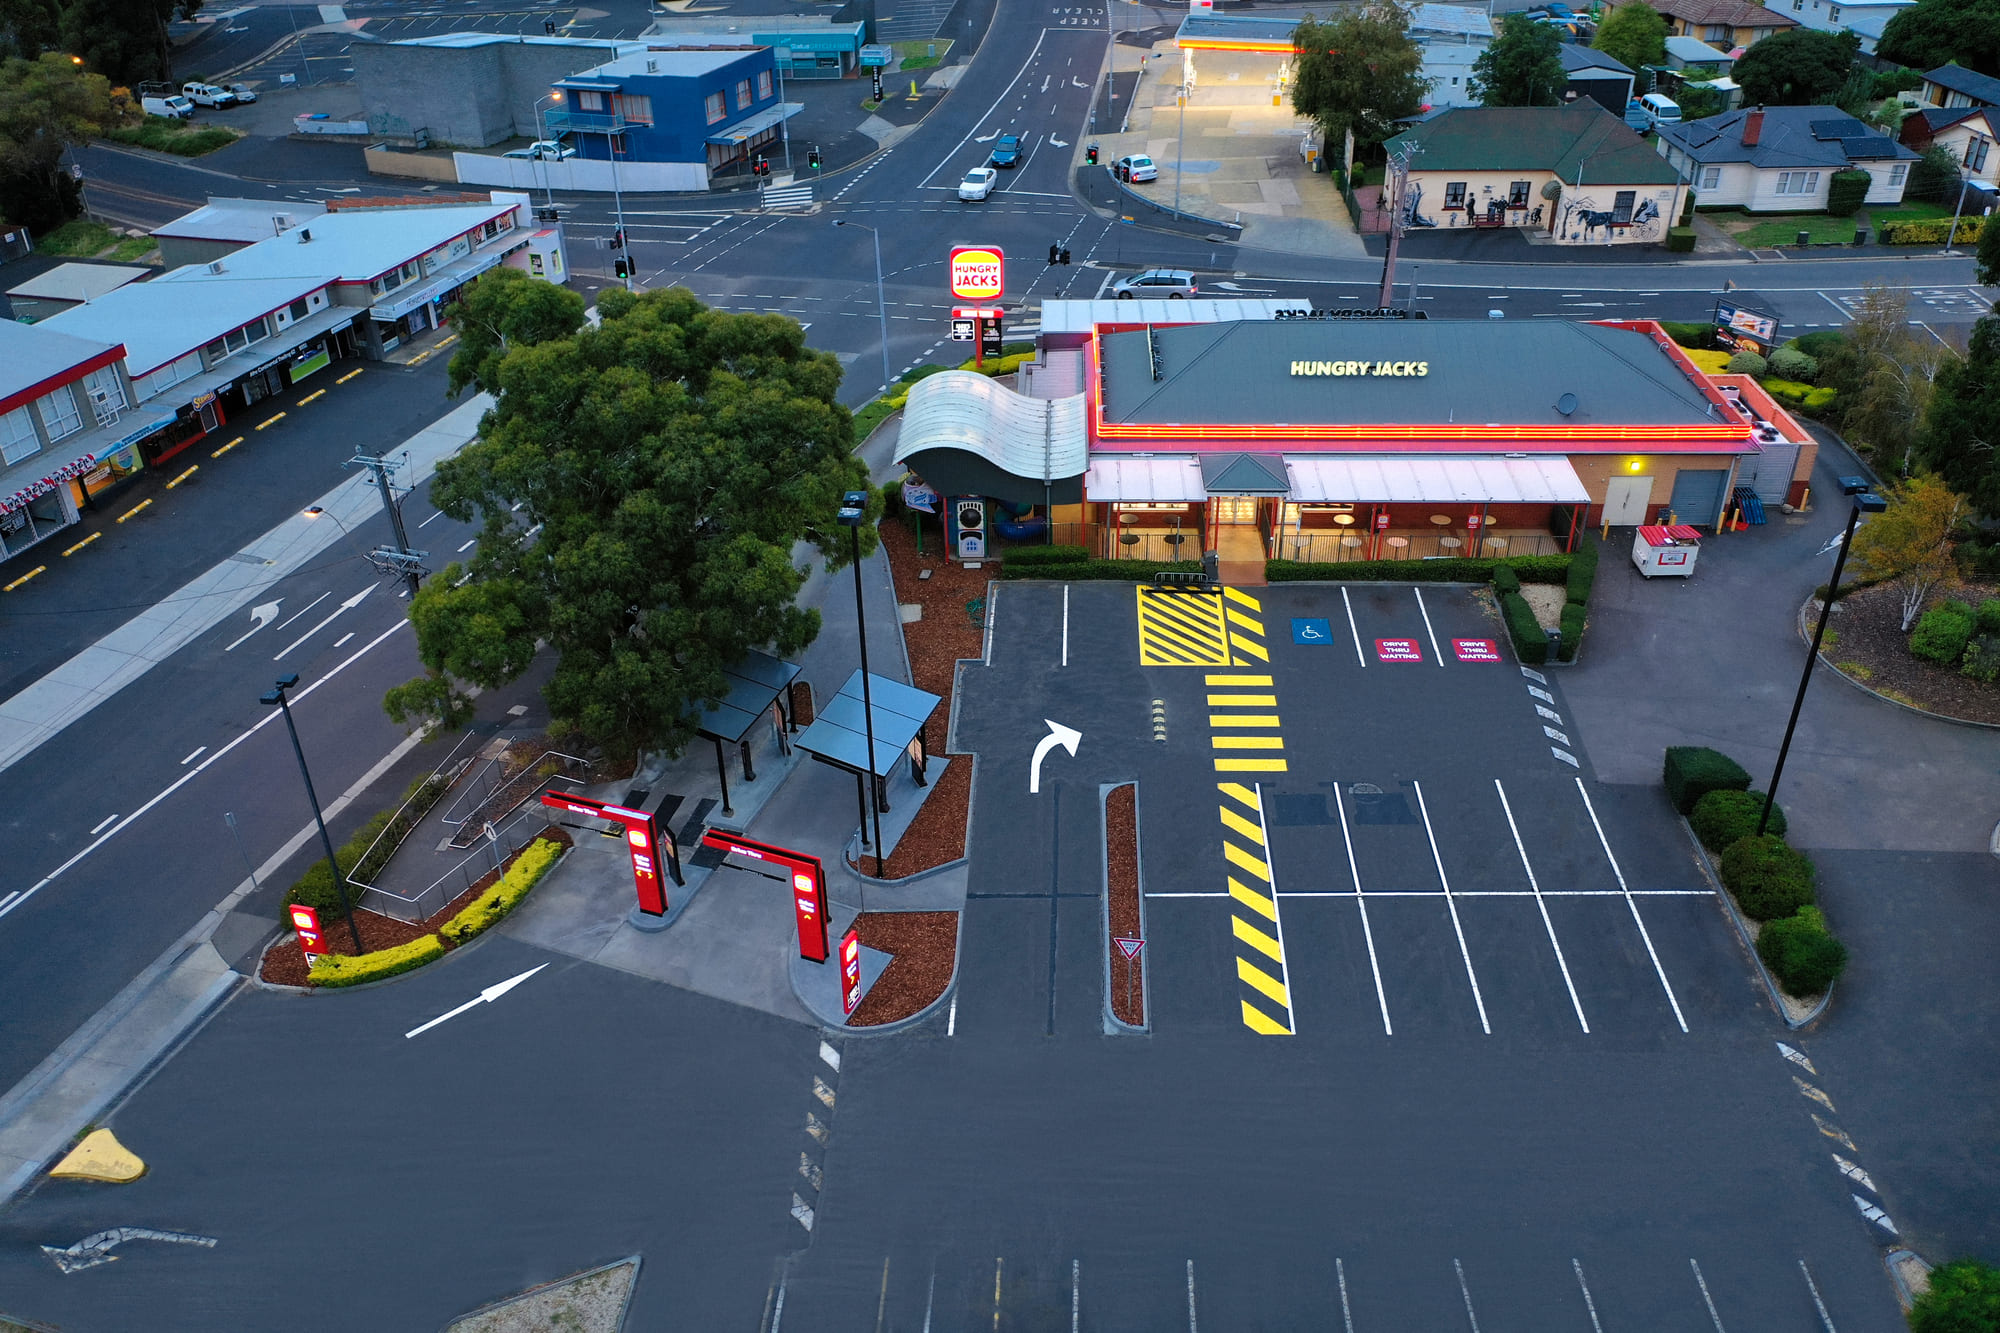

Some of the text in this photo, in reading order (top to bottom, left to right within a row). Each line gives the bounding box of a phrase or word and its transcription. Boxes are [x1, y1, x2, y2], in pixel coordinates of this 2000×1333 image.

[1052, 7, 1104, 15] CLEAR
[1059, 17, 1100, 26] KEEP
[955, 265, 998, 273] HUNGRY
[1290, 360, 1371, 376] HUNGRY
[53, 458, 90, 484] BARBER
[7, 482, 45, 509] BARBER
